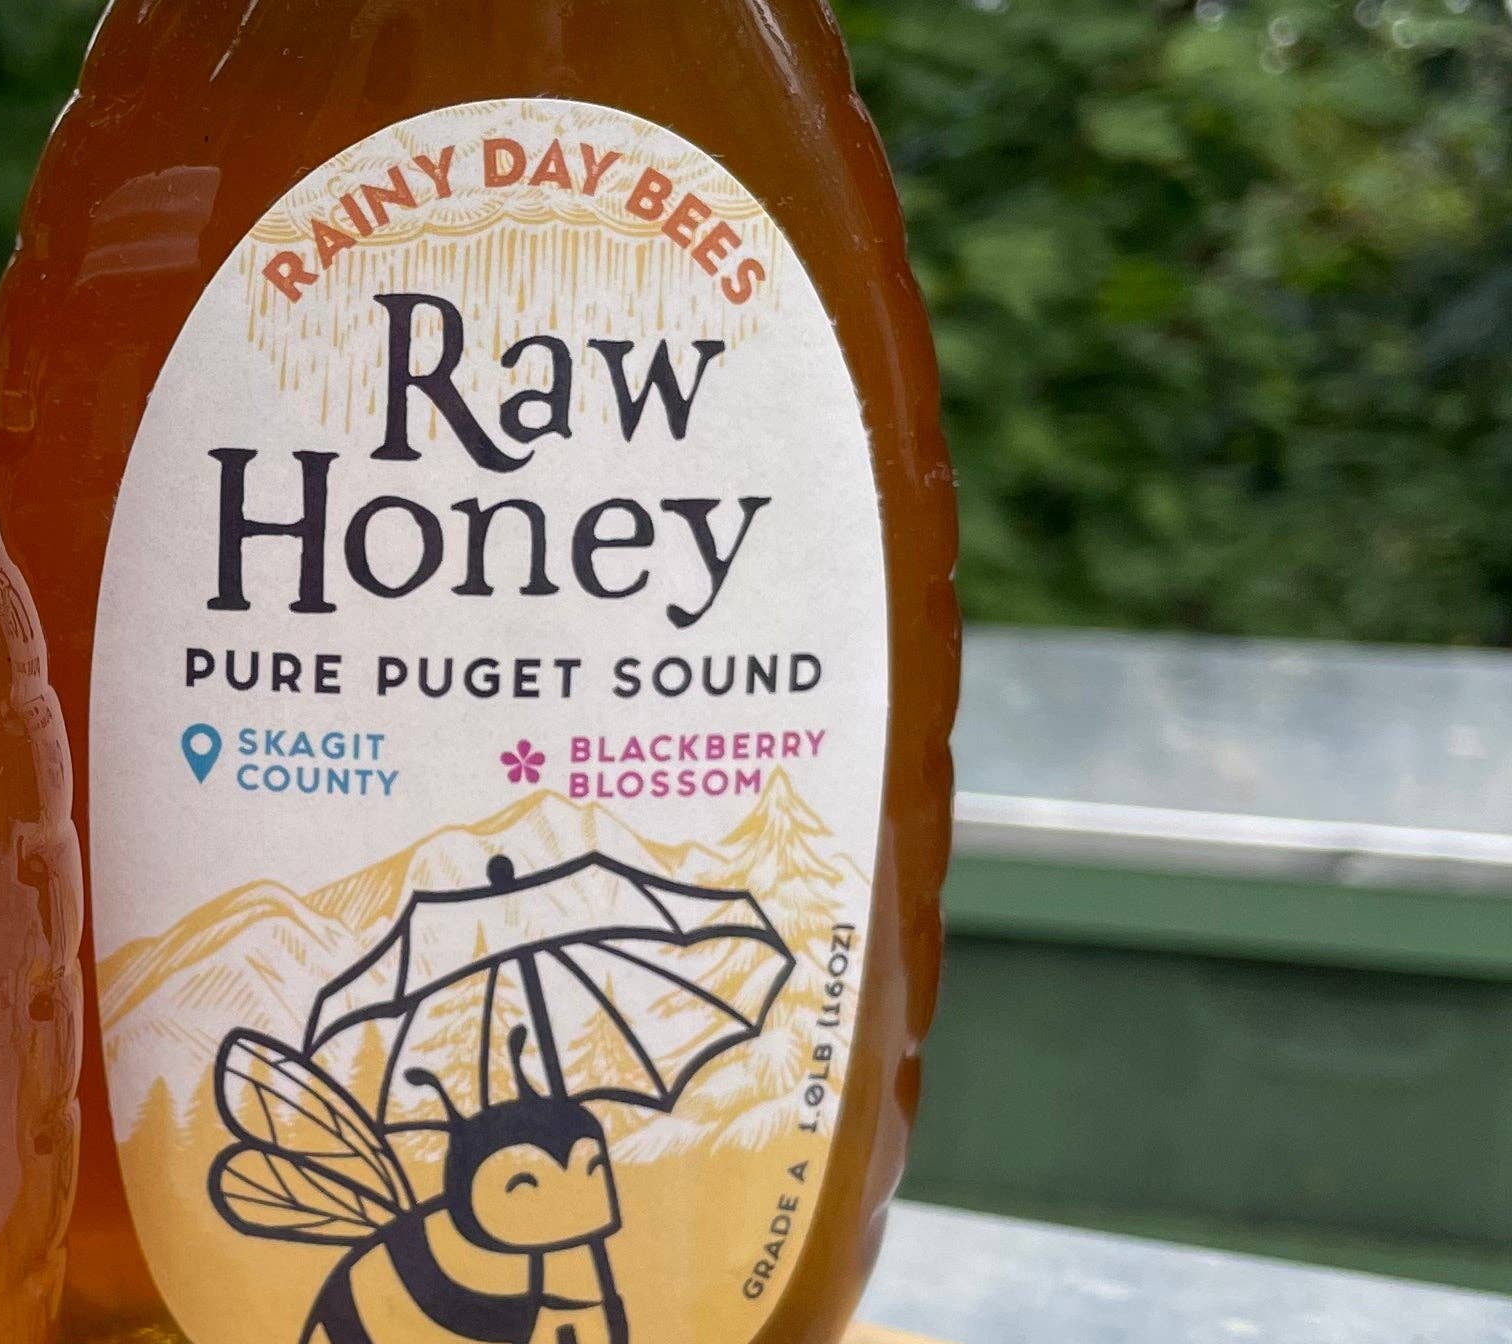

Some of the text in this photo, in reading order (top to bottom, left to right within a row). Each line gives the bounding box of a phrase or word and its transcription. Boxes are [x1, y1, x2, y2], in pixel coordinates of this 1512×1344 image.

[261, 138, 768, 307] RAINY DAY BEES
[371, 292, 726, 474] Raw
[206, 447, 772, 629] Honey
[185, 647, 823, 699] PURE PUGET SOUND
[238, 728, 385, 761] SKAGIT
[570, 731, 827, 764] BLACKBERRY
[236, 764, 400, 798] COUNTY
[570, 769, 762, 799] BLOSSOM
[741, 1193, 799, 1302] GRADE
[787, 1159, 810, 1183] A
